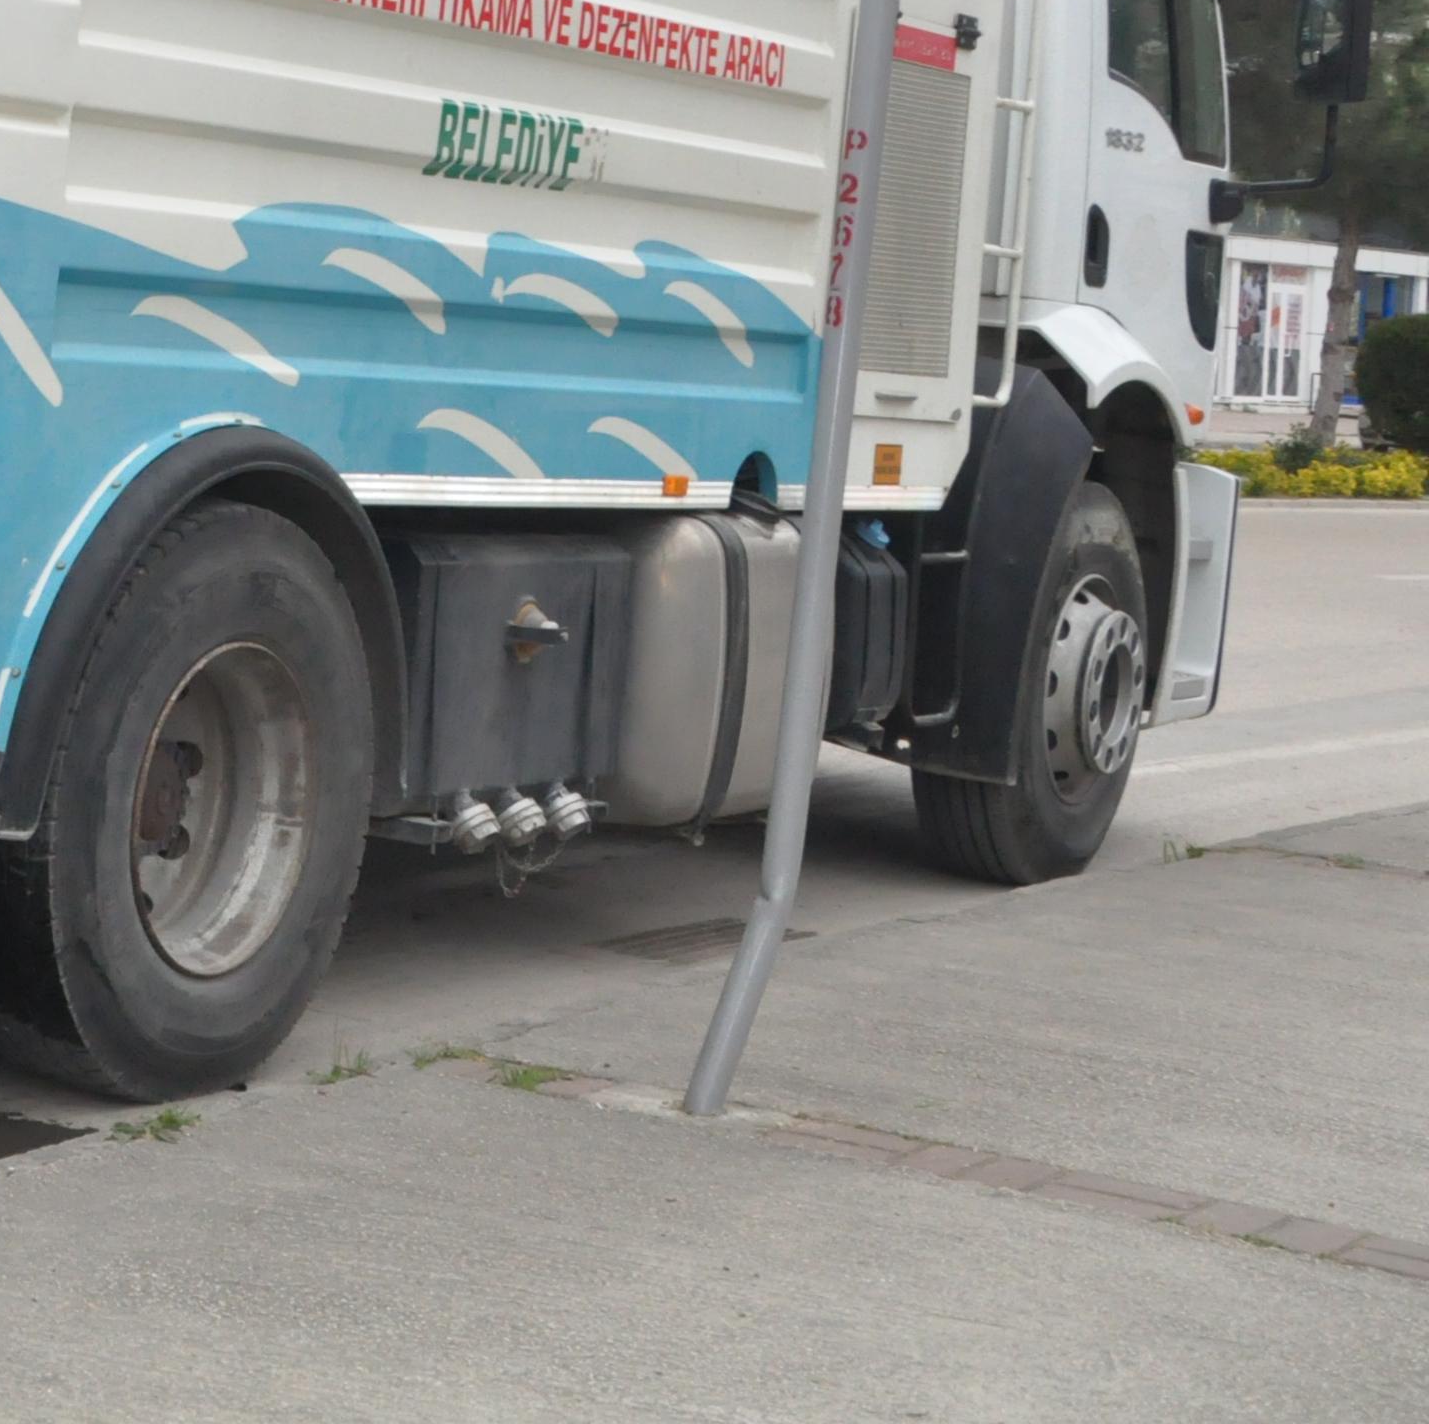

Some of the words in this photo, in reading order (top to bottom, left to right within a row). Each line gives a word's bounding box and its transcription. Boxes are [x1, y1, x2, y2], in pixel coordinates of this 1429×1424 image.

[578, 1, 719, 76] DEZENFEKTE
[722, 34, 785, 88] ARACI
[1105, 126, 1145, 153] 1832
